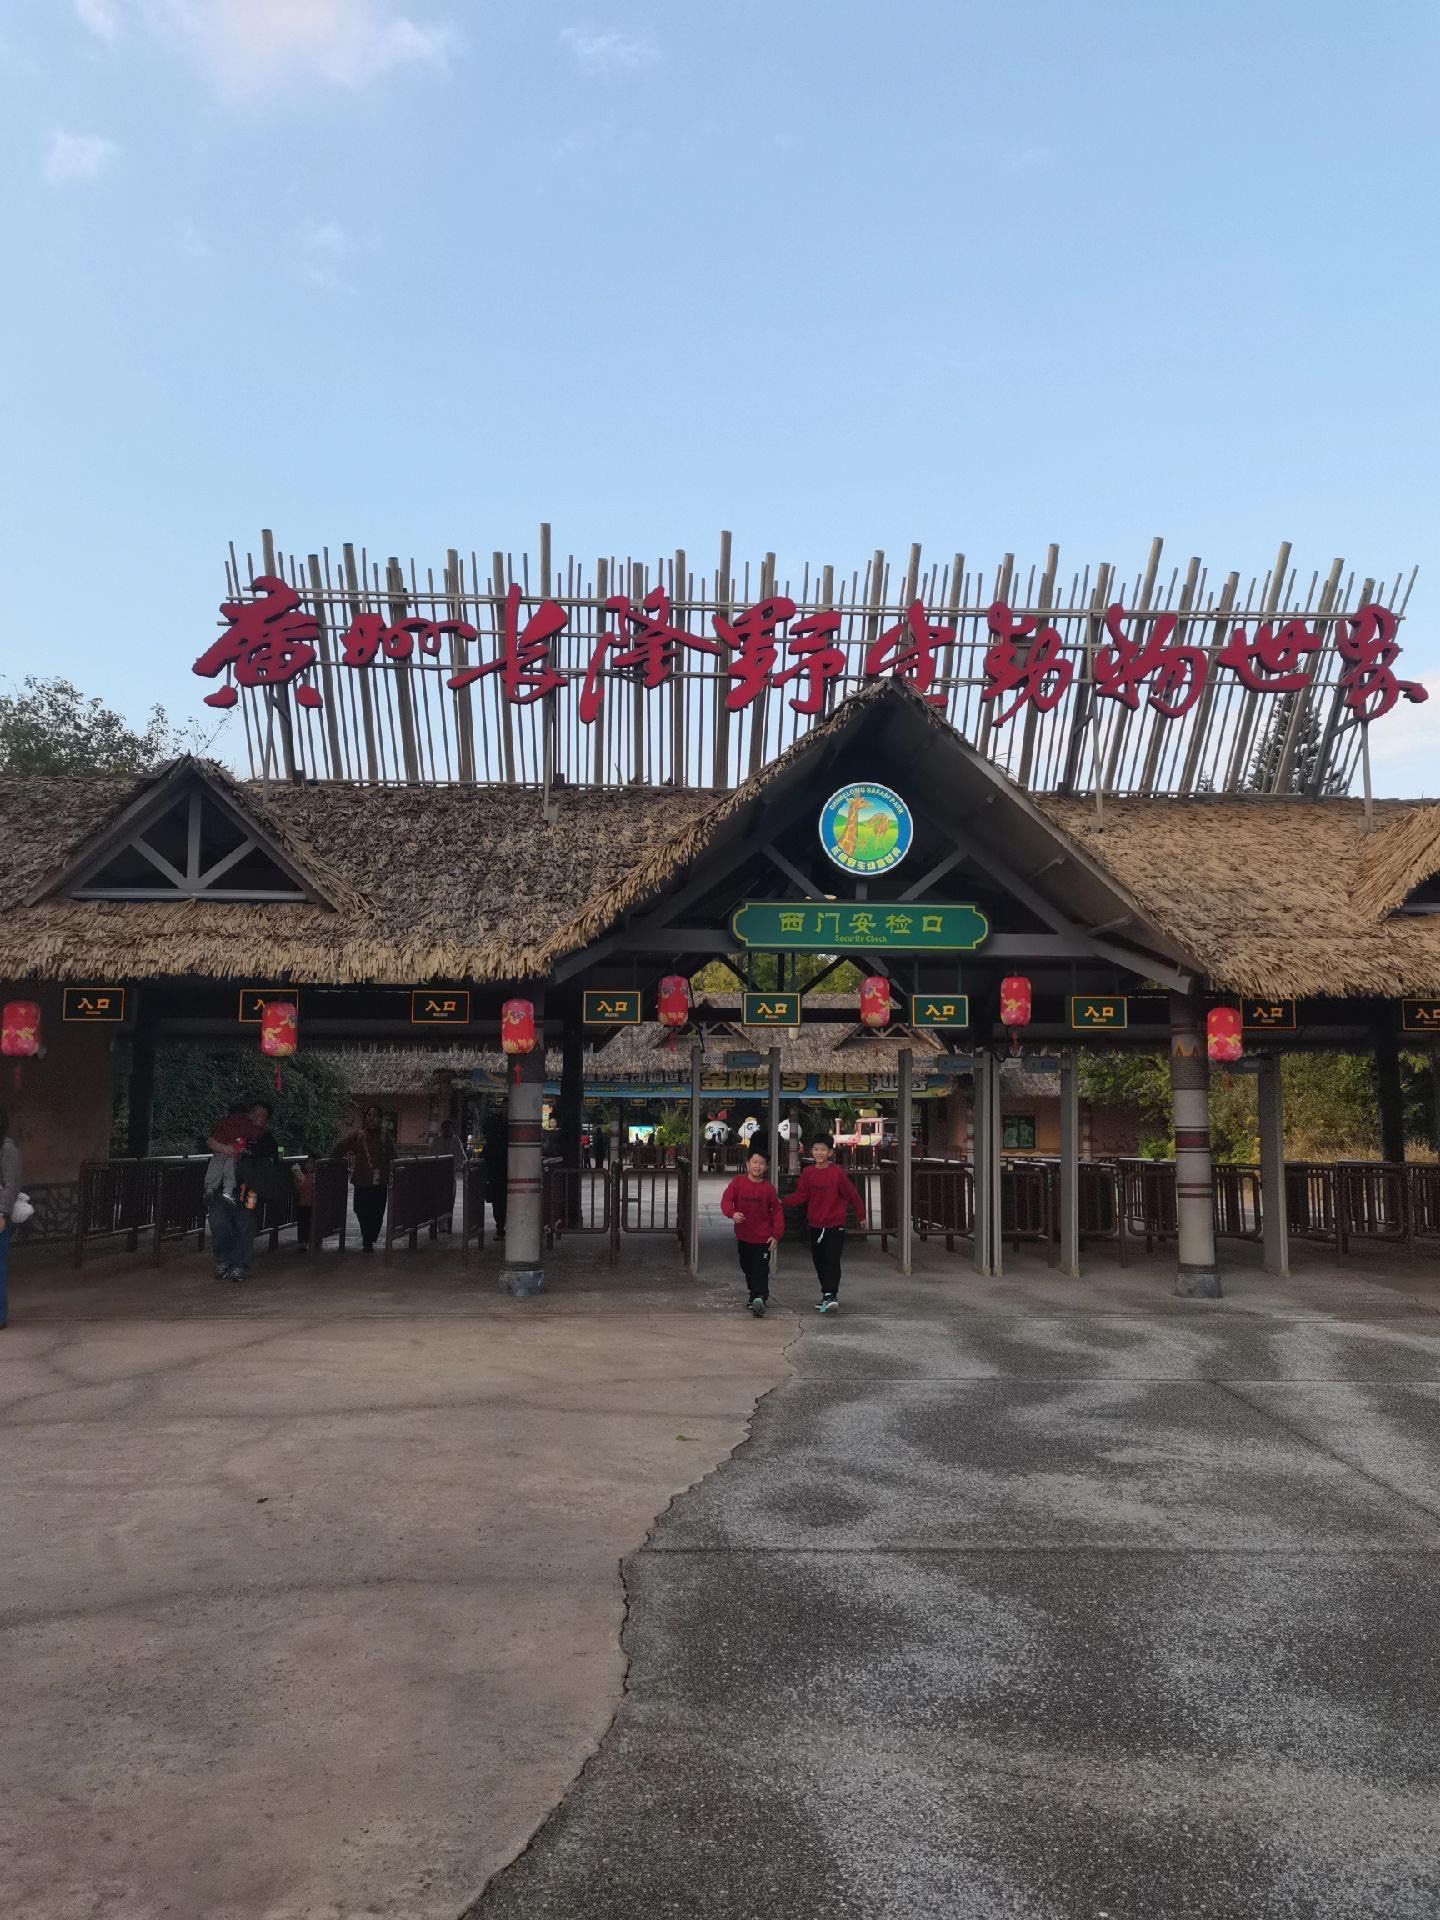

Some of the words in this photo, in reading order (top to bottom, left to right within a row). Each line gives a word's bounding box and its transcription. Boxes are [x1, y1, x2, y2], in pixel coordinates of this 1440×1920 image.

[778, 911, 944, 934] 西门安检口
[834, 934, 864, 943] Security
[866, 934, 887, 943] Check
[77, 997, 111, 1009] 入口
[425, 1000, 457, 1012] 入口
[597, 1001, 628, 1013] 入口
[757, 1002, 788, 1014] 入口
[924, 1004, 956, 1016] 入口
[1084, 1006, 1115, 1018] 入口
[1253, 1006, 1284, 1018] 入口
